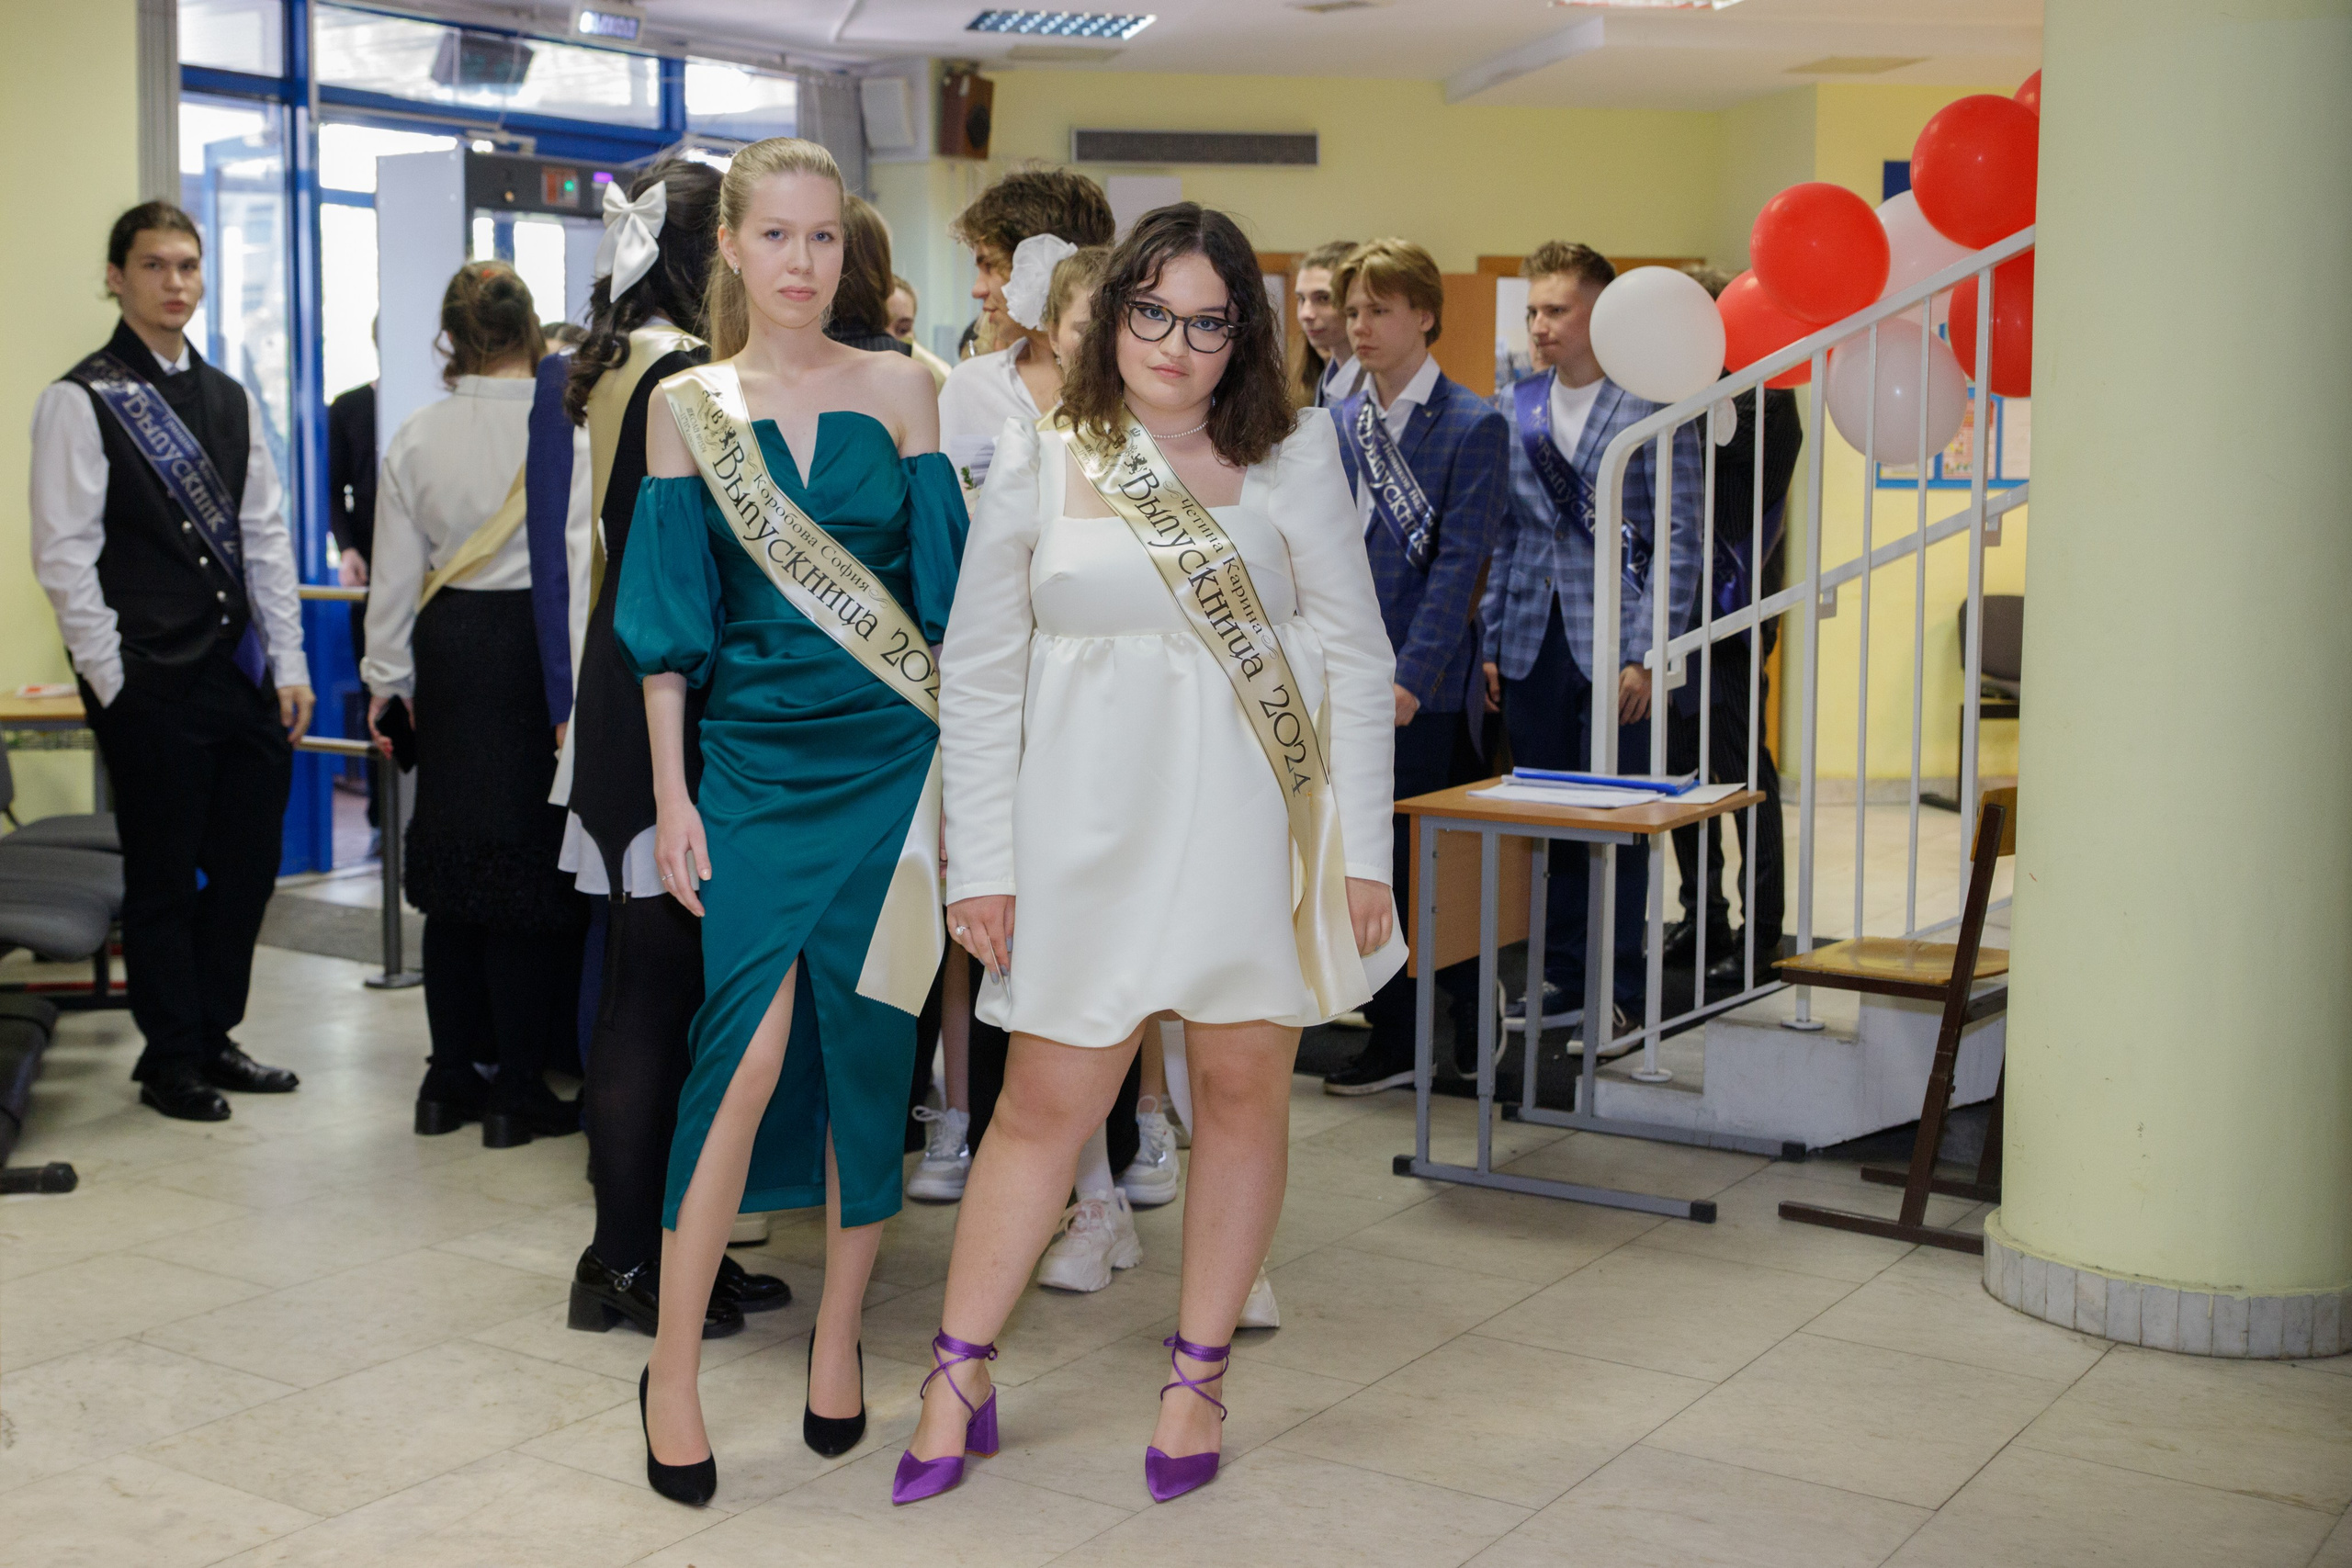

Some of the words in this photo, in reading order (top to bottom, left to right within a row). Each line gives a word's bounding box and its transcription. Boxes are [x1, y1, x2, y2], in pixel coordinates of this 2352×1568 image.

[123, 390, 227, 534] Выпускник
[753, 473, 818, 548] Коробова
[820, 544, 869, 592] София
[713, 441, 879, 642] Выпускница
[880, 626, 940, 702] 202
[1118, 468, 1264, 682] Выпускница
[1259, 683, 1311, 797] 2024
[1181, 497, 1224, 553] Четина
[1222, 555, 1263, 636] Карина
